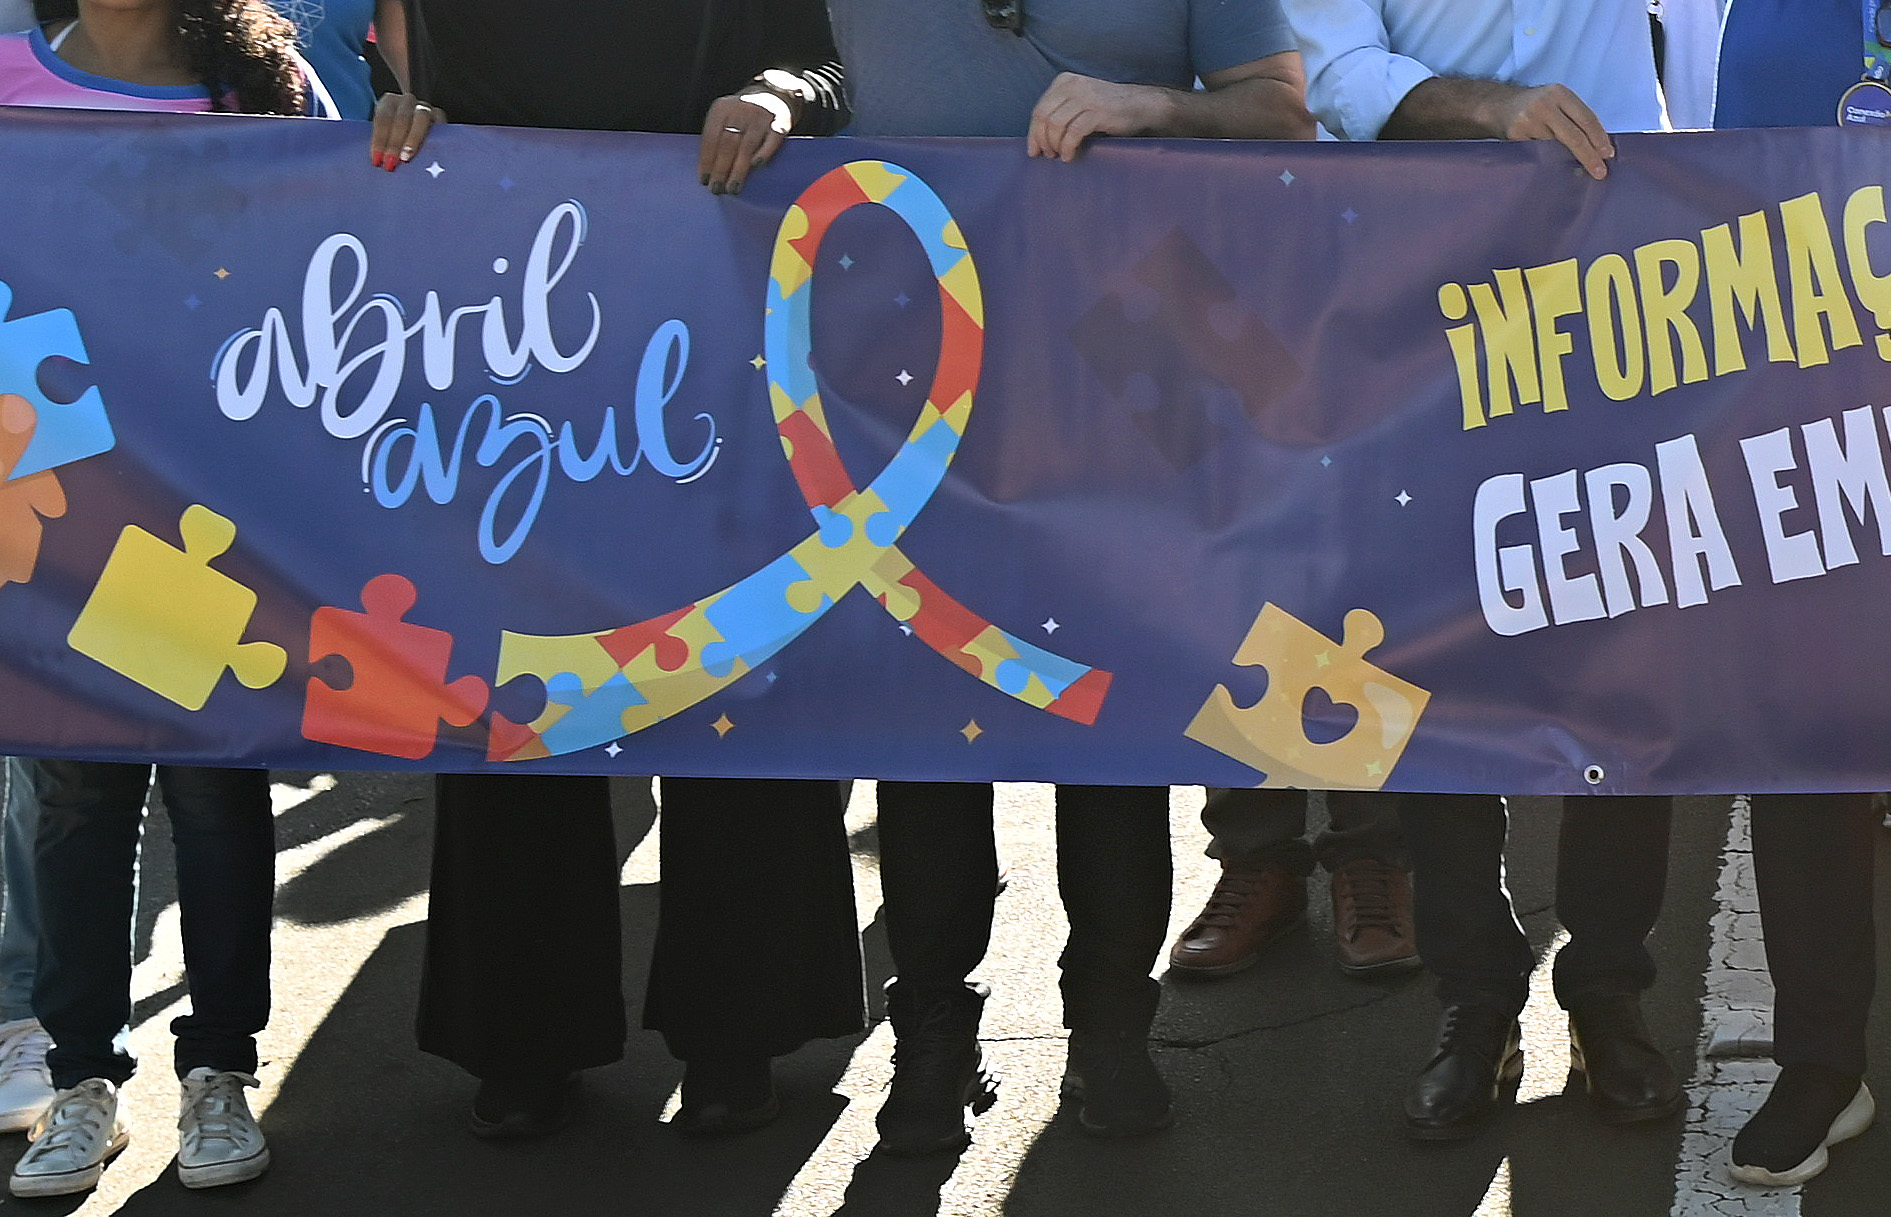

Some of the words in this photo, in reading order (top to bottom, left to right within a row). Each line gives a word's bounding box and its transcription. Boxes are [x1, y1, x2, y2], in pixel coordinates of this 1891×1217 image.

[215, 200, 602, 440] abril
[371, 318, 718, 565] azul
[1472, 432, 1742, 638] GERA
